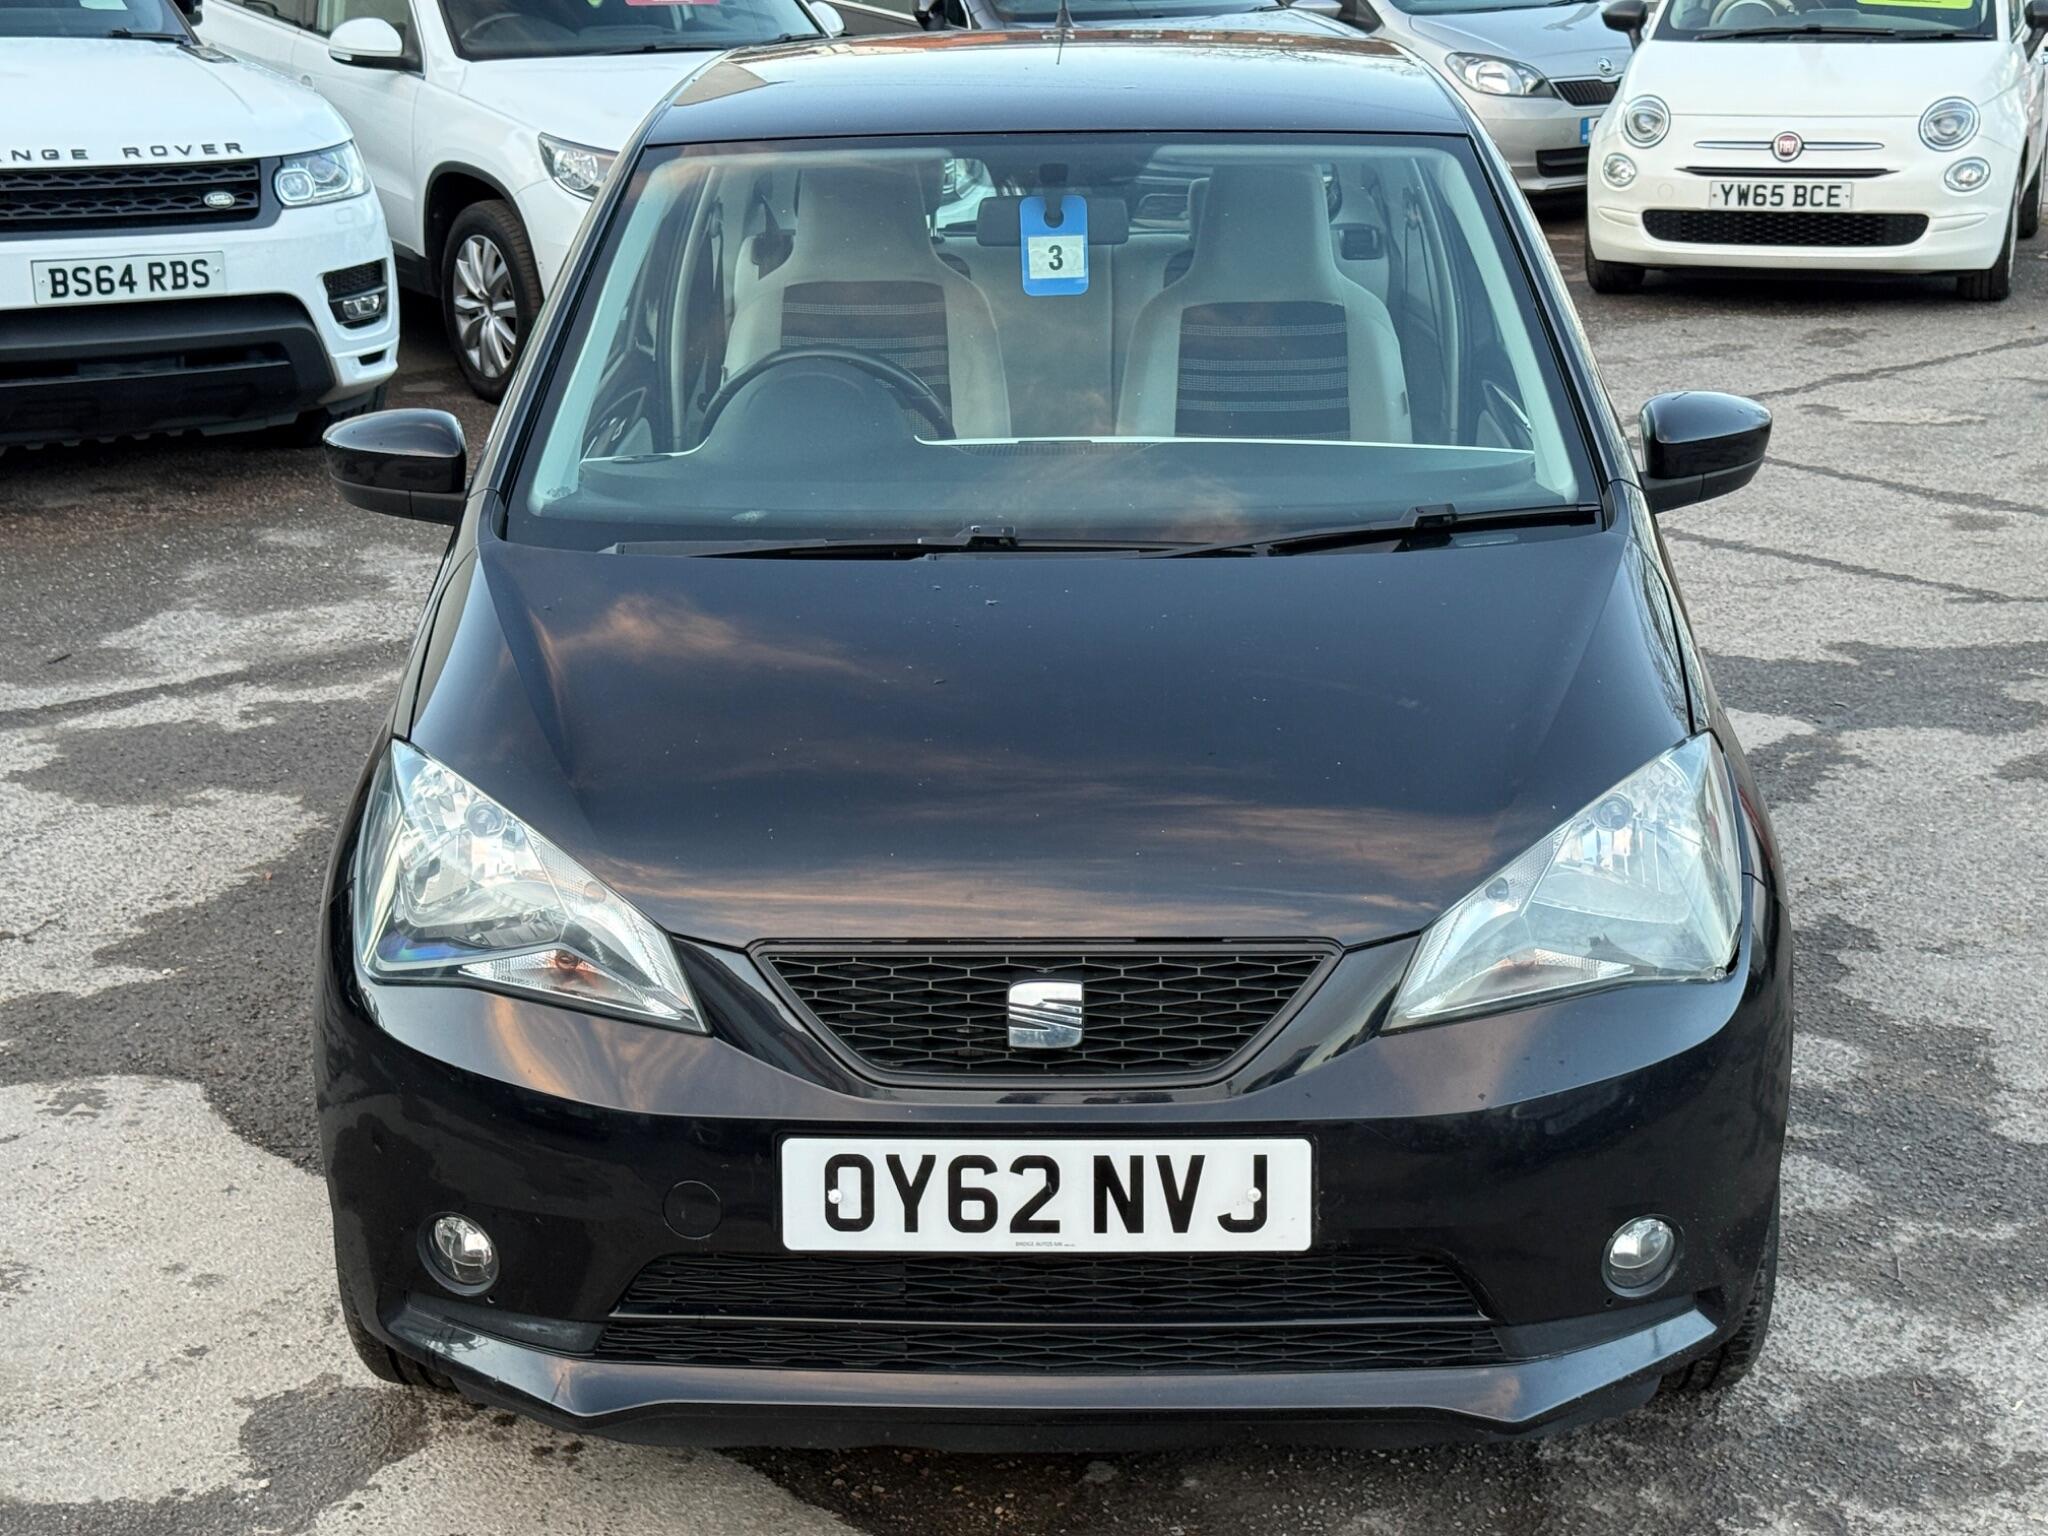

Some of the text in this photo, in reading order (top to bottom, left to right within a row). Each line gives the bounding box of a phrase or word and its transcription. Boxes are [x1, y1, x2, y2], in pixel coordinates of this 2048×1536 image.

[0, 142, 244, 162] NGE ROVER
[1721, 183, 1842, 207] YW65 BCE
[1048, 244, 1064, 271] 3
[48, 258, 210, 299] BS64 RBS
[824, 1153, 1269, 1234] OY62 NVJ
